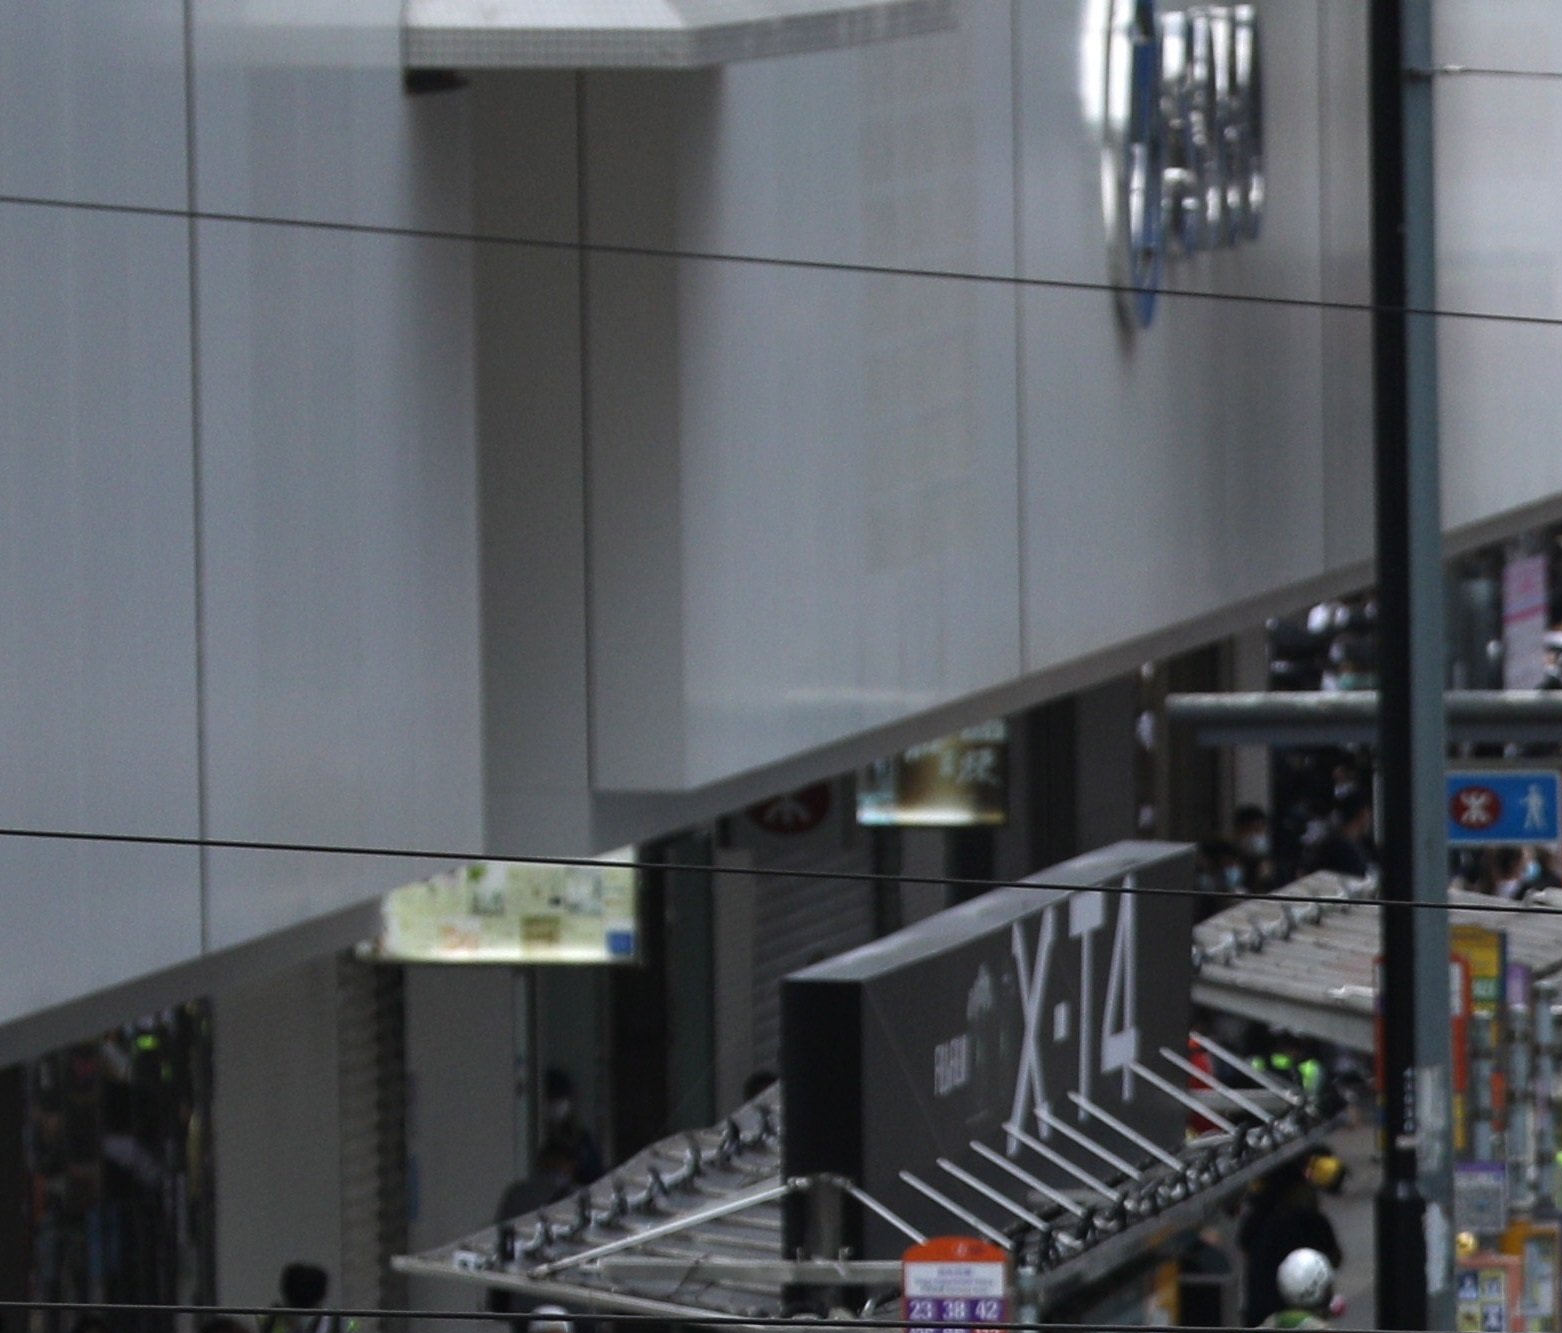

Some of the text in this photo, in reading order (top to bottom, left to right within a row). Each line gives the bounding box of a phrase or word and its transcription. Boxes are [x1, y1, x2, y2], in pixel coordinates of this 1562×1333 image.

[909, 1301, 999, 1320] 23 38 42
